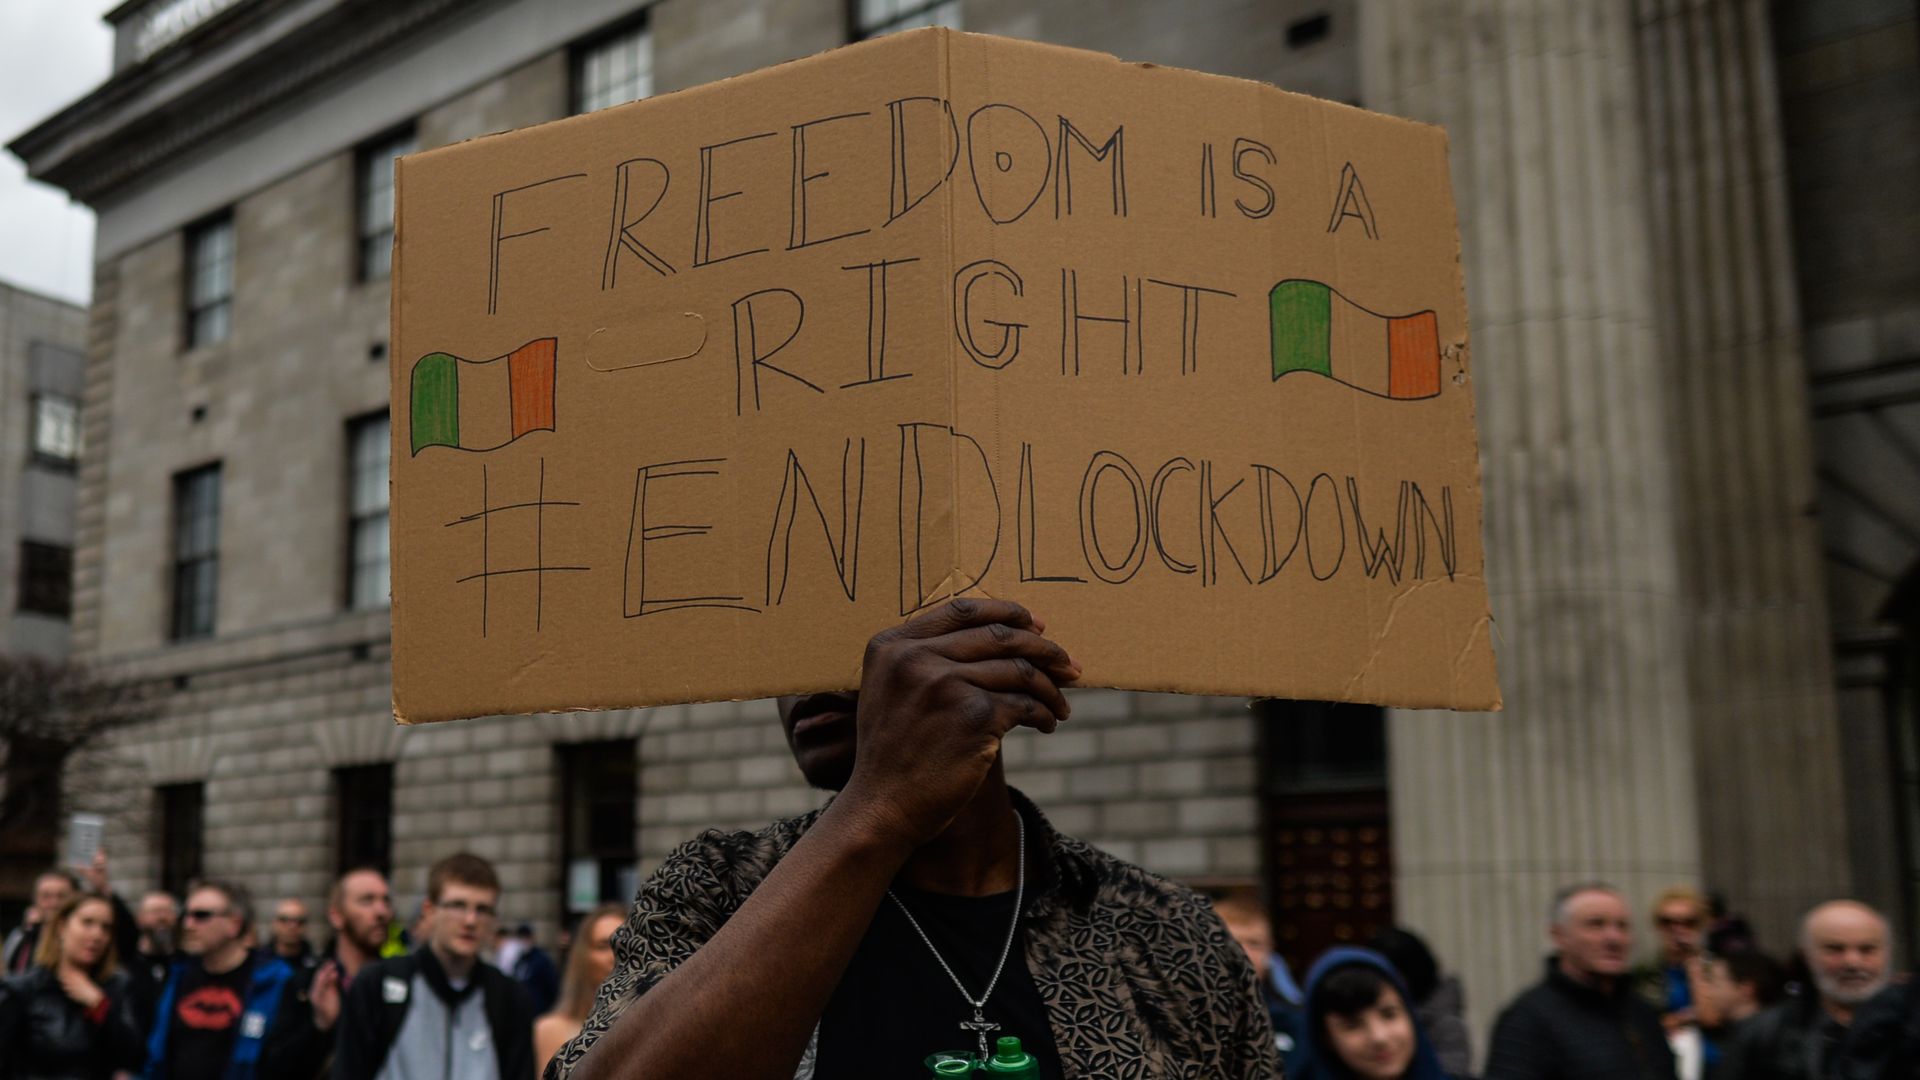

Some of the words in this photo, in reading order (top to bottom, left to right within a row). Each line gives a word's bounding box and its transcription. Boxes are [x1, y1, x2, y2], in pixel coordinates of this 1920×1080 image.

[488, 96, 1127, 315] FREEDOM
[1202, 137, 1277, 219] IS
[1326, 161, 1380, 240] A
[731, 257, 1237, 416] RIGHT
